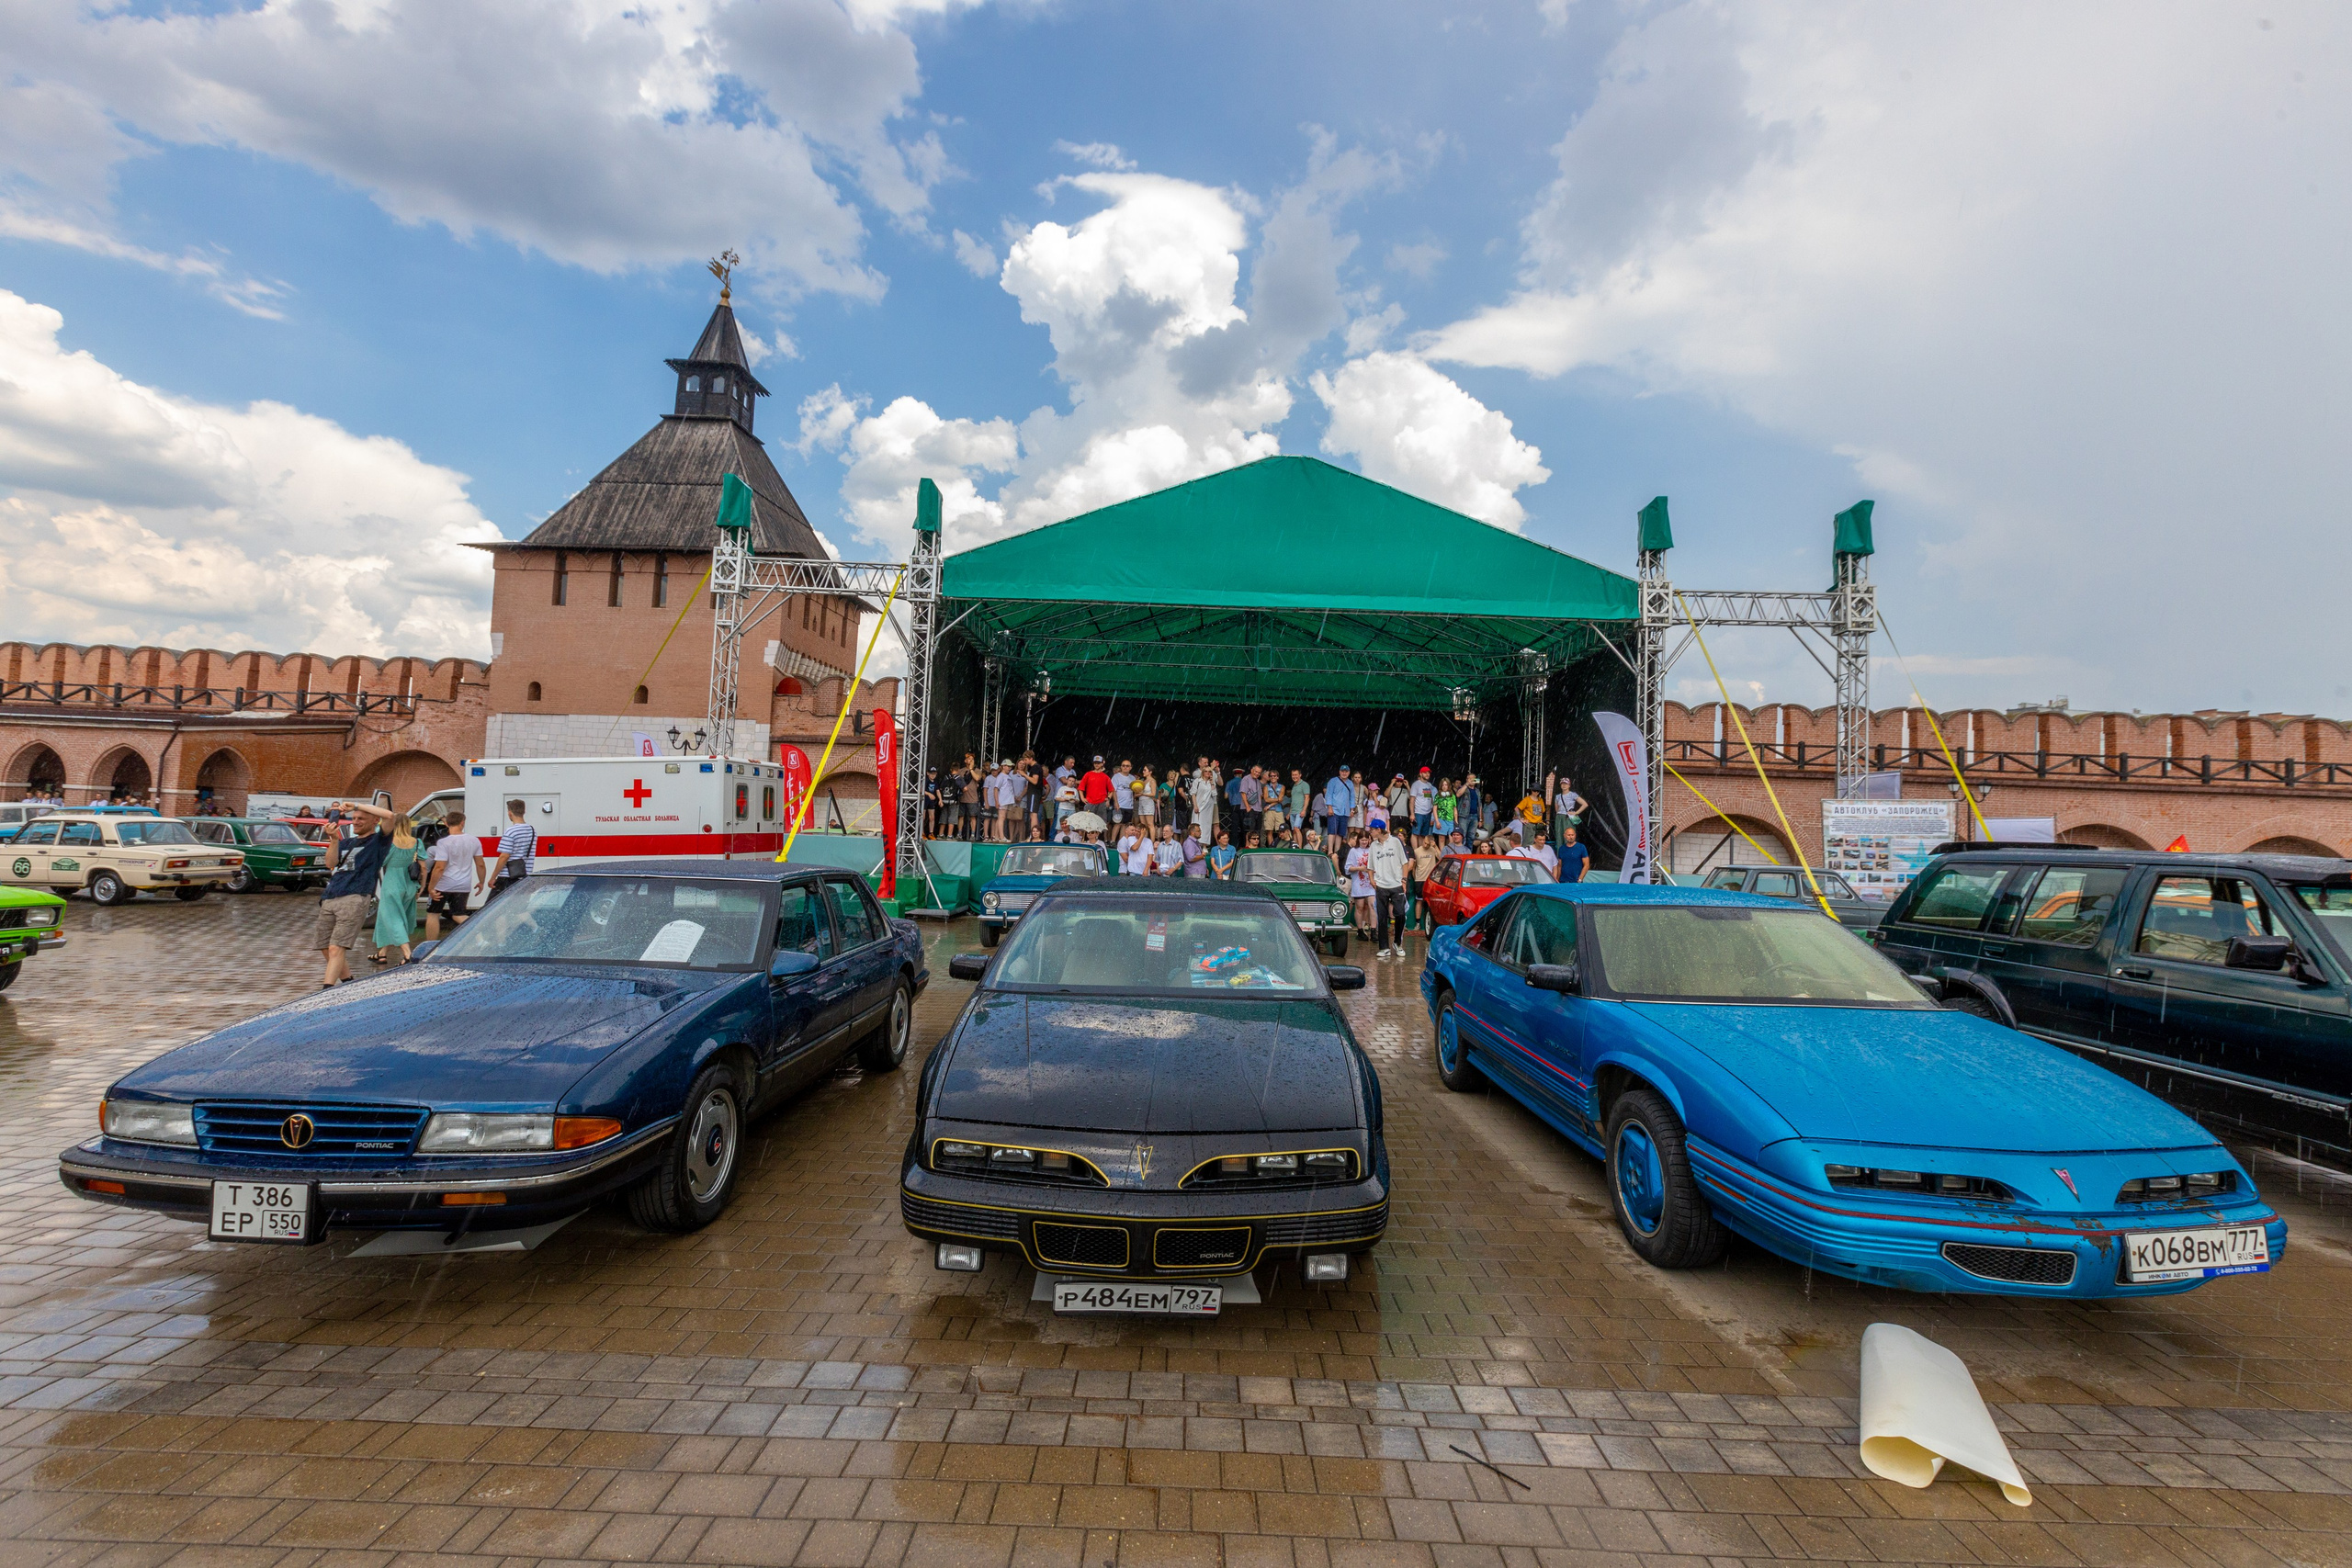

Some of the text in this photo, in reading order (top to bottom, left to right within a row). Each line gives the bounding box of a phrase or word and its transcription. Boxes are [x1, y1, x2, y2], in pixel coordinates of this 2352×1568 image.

[1882, 807, 1944, 815] «ЗАПОРОЖЕЦ»
[14, 862, 30, 874] 66
[253, 1186, 293, 1207] 386
[268, 1213, 301, 1230] 550
[2228, 1230, 2258, 1252] 777
[2237, 1252, 2253, 1261] RUS
[1173, 1288, 1214, 1304] 797
